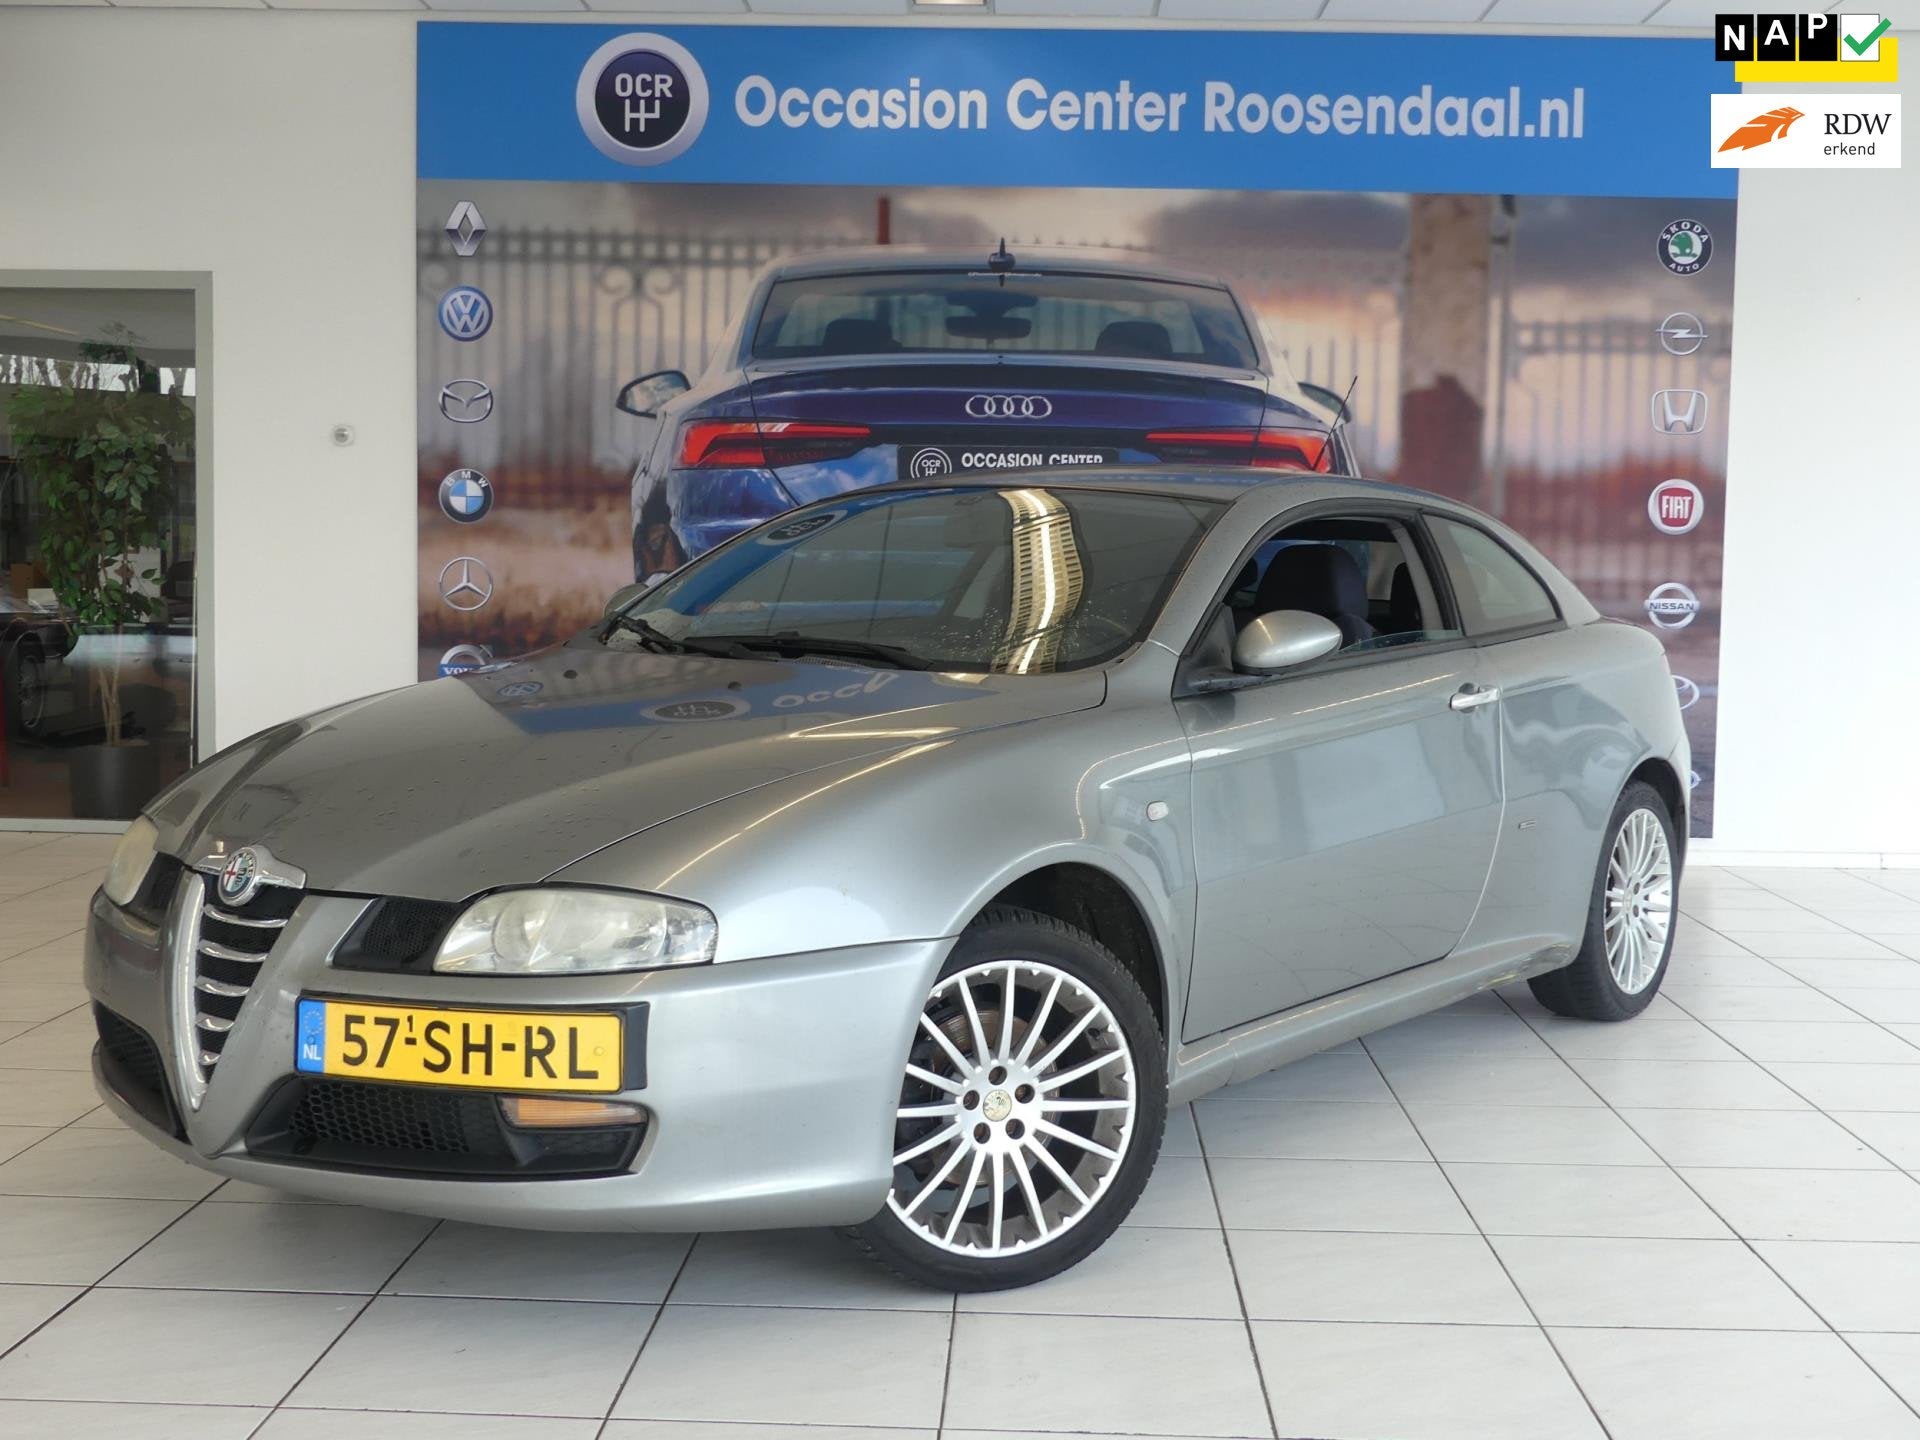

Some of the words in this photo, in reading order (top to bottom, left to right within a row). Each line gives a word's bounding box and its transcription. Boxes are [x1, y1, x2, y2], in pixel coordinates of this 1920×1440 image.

[615, 72, 673, 98] OCR
[735, 75, 988, 129] Occasion
[1006, 78, 1187, 132] Center
[1203, 81, 1584, 139] Roosendaal.nl
[1669, 263, 1700, 272] AUTO
[921, 459, 941, 468] OCR
[961, 452, 1043, 468] OCCASION
[444, 471, 489, 488] BMW
[1661, 495, 1692, 519] FIAT
[1649, 602, 1694, 611] NISSAN
[303, 1044, 321, 1061] NL
